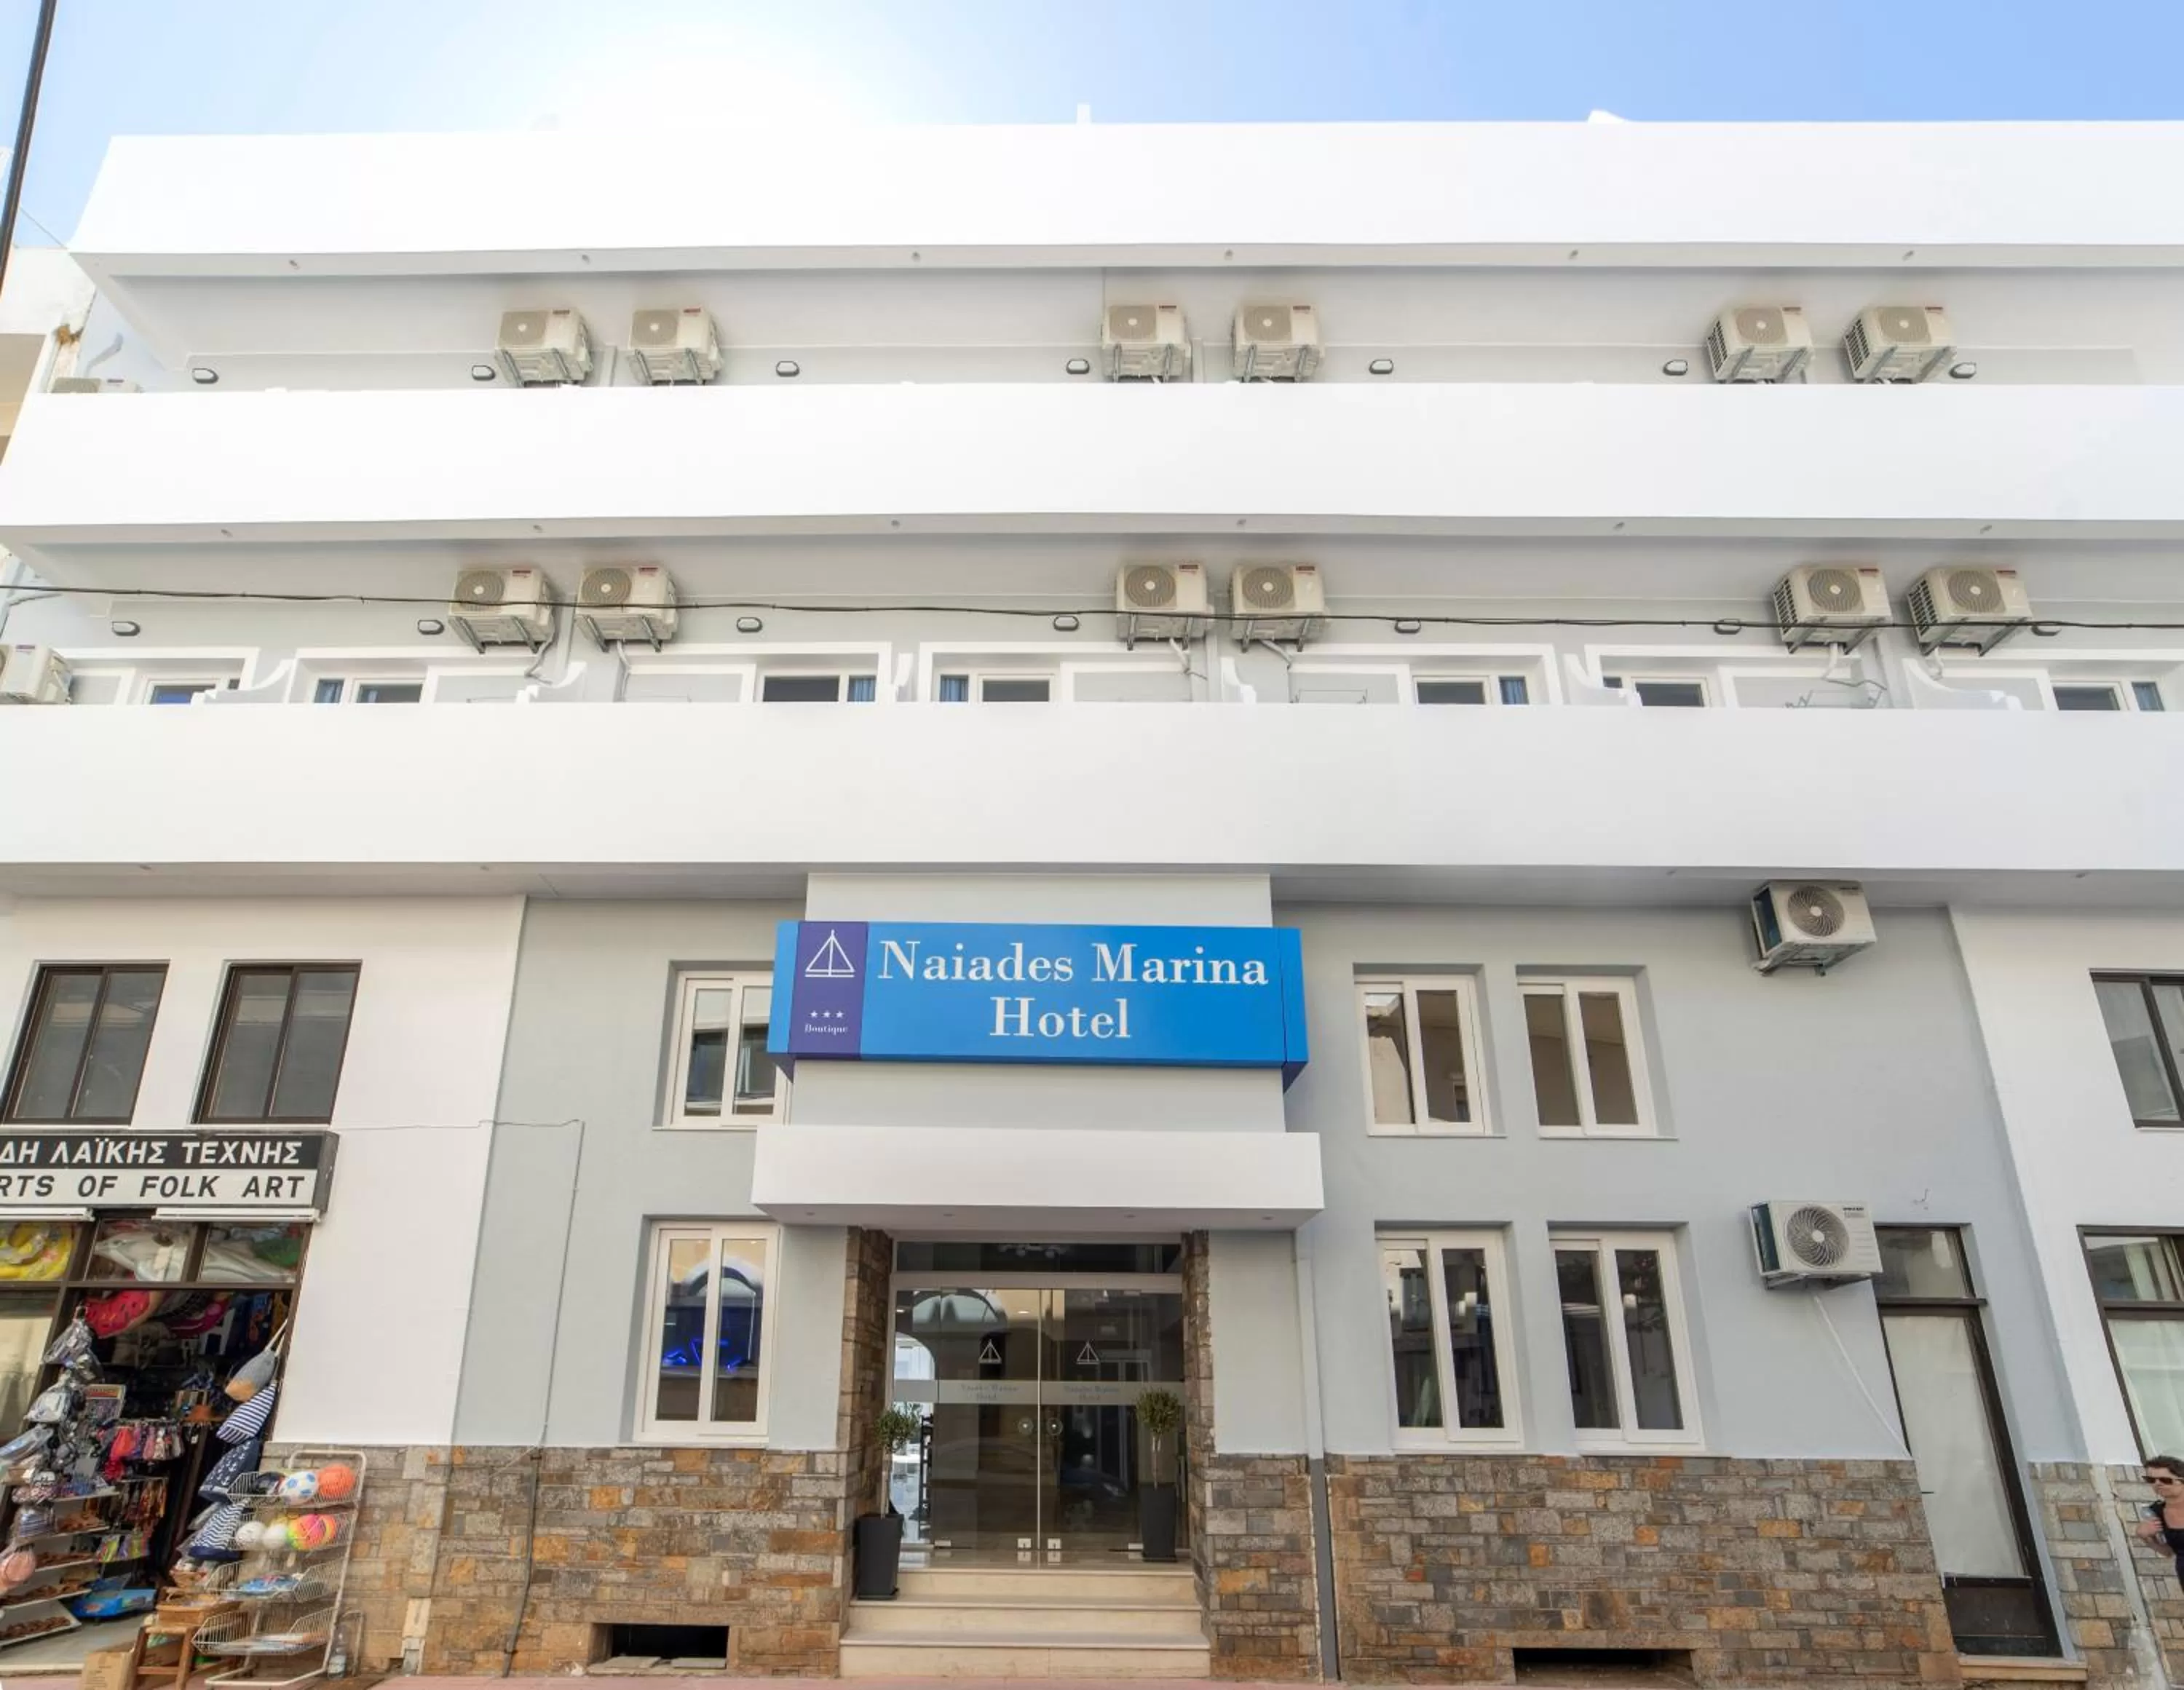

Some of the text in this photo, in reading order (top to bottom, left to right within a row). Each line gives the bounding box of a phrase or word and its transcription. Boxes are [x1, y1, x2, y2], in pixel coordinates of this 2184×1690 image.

[877, 940, 1268, 985] Naiades Marina
[804, 1023, 848, 1036] Boutique
[989, 996, 1131, 1039] Hotel
[49, 1138, 167, 1165] ΛΑΪΚΗΣ
[181, 1140, 302, 1165] ΤΕΧΝΗΣ
[77, 1175, 118, 1198] OF
[139, 1175, 221, 1198] FOLK
[241, 1175, 305, 1199] ART
